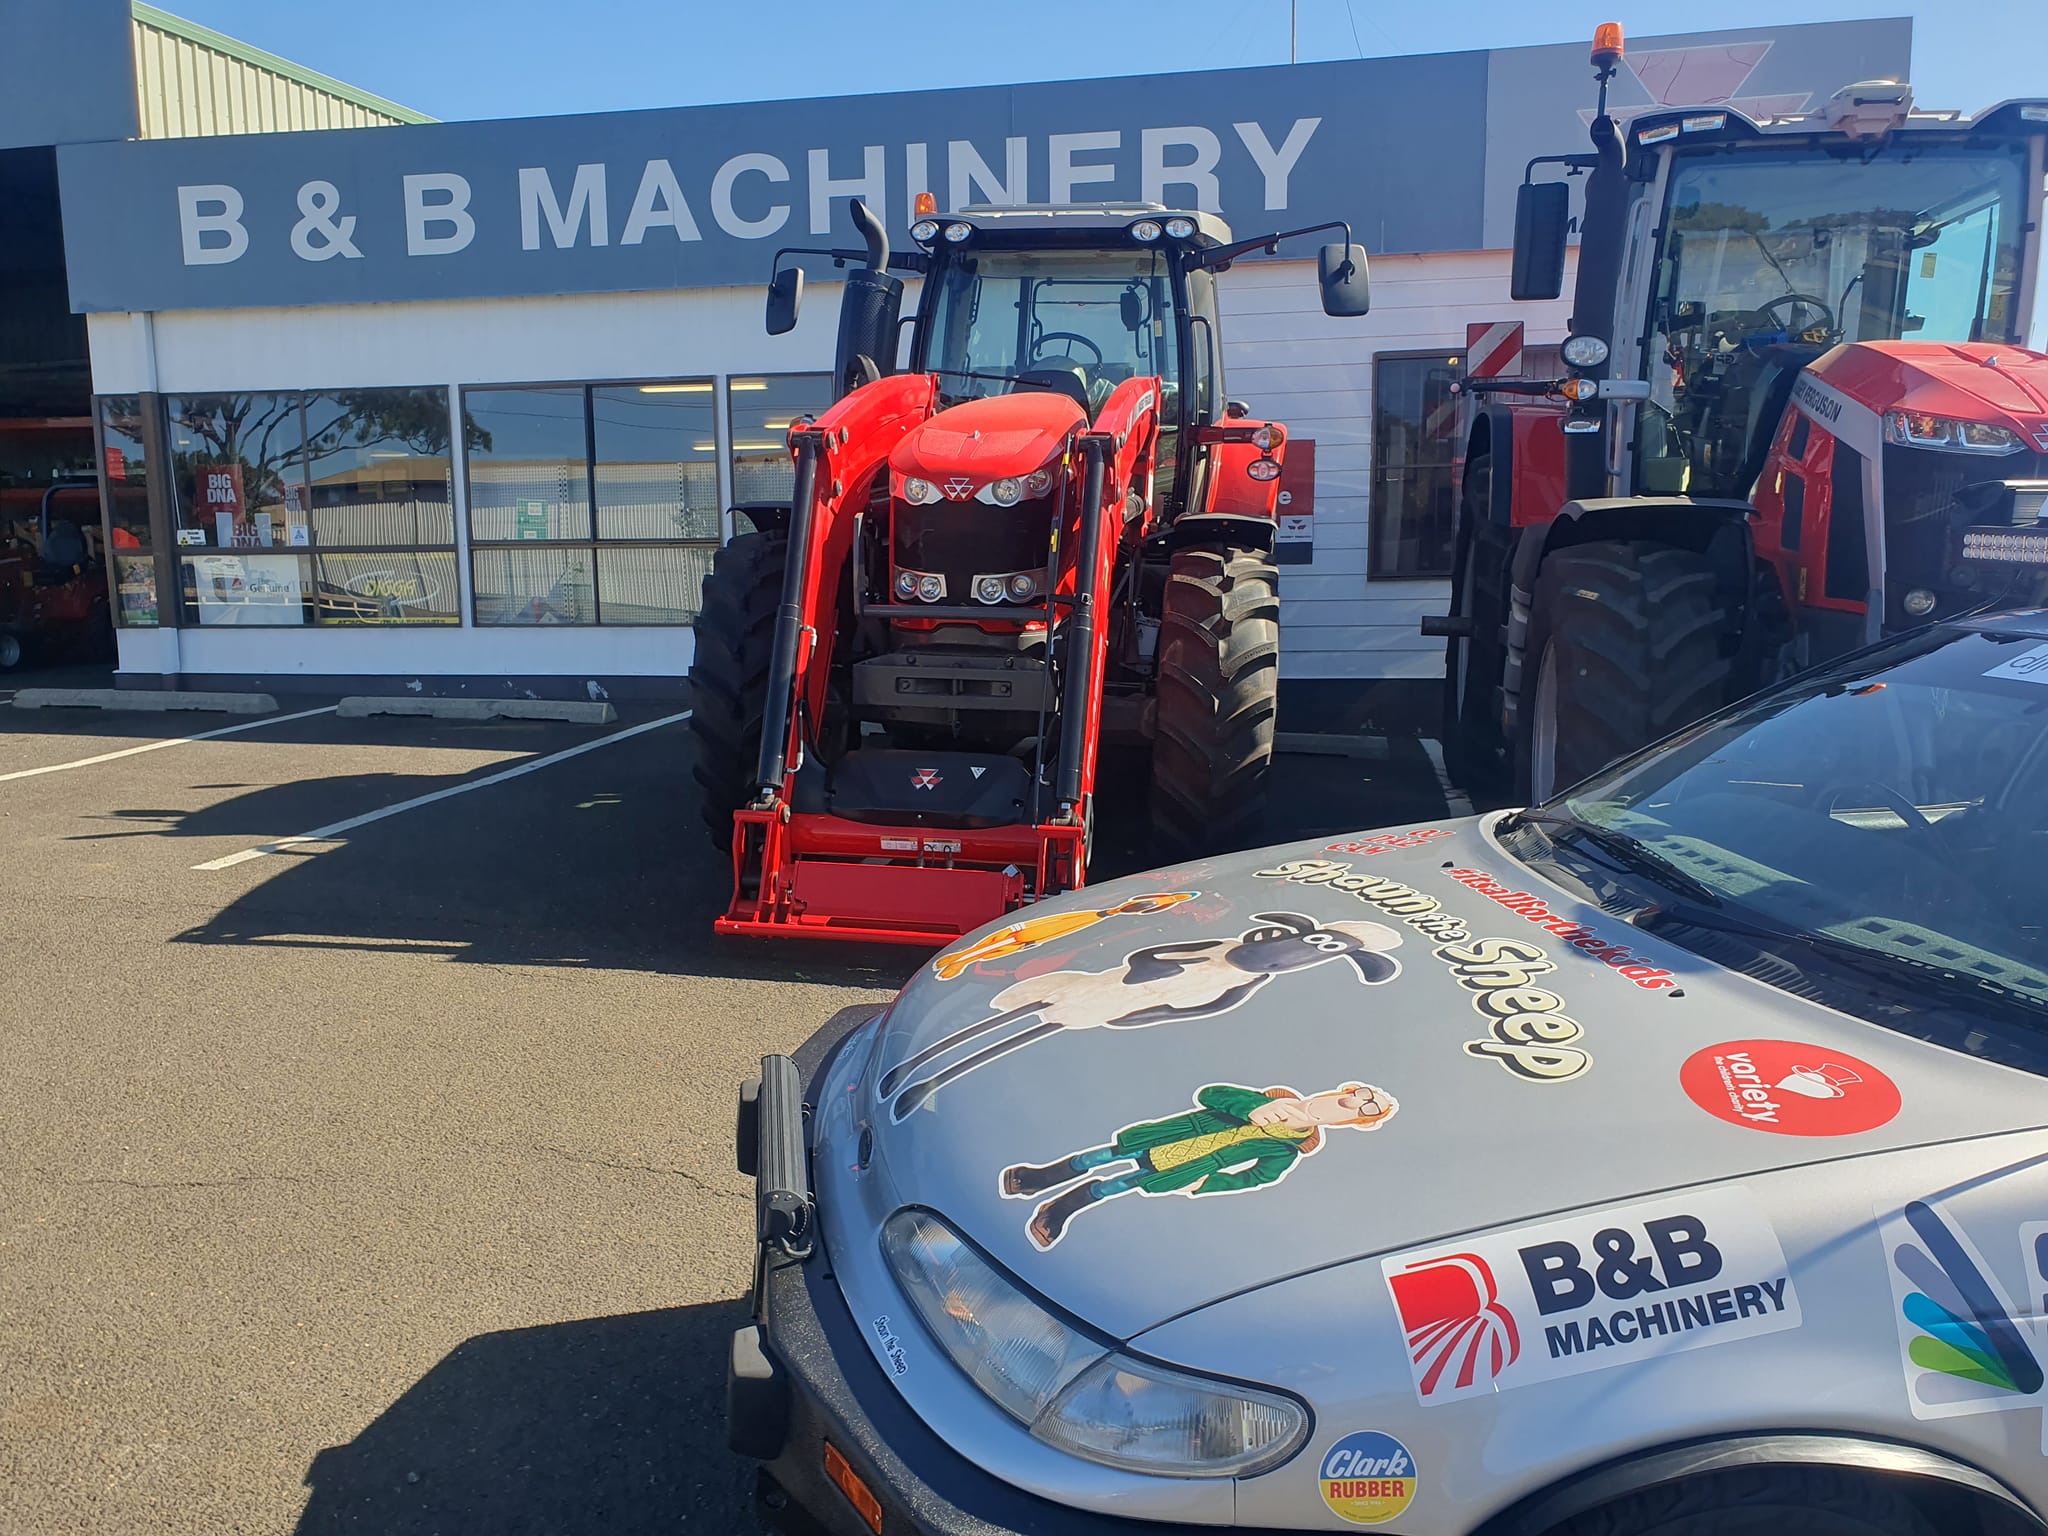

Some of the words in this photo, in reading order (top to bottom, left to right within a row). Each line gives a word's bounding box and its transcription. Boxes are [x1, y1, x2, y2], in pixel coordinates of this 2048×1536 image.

[177, 184, 249, 265] B
[290, 180, 365, 261] &
[403, 172, 476, 256] B
[518, 117, 1323, 250] MACHINERY
[1802, 385, 1842, 423] FERGUSON
[207, 488, 237, 503] DNA
[208, 474, 232, 488] BIG
[285, 487, 299, 499] BIG
[233, 523, 258, 536] BIG
[1253, 860, 1440, 916] Shaun
[1404, 912, 1468, 944] the
[1435, 938, 1590, 1080] Sheep
[1726, 1052, 1781, 1123] variety
[1517, 1214, 1723, 1317] B&B
[1544, 1278, 1787, 1359] MACHINERY
[890, 1348, 907, 1377] Sheep
[1325, 1449, 1409, 1478] Clark
[1329, 1480, 1405, 1498] RUBBER
